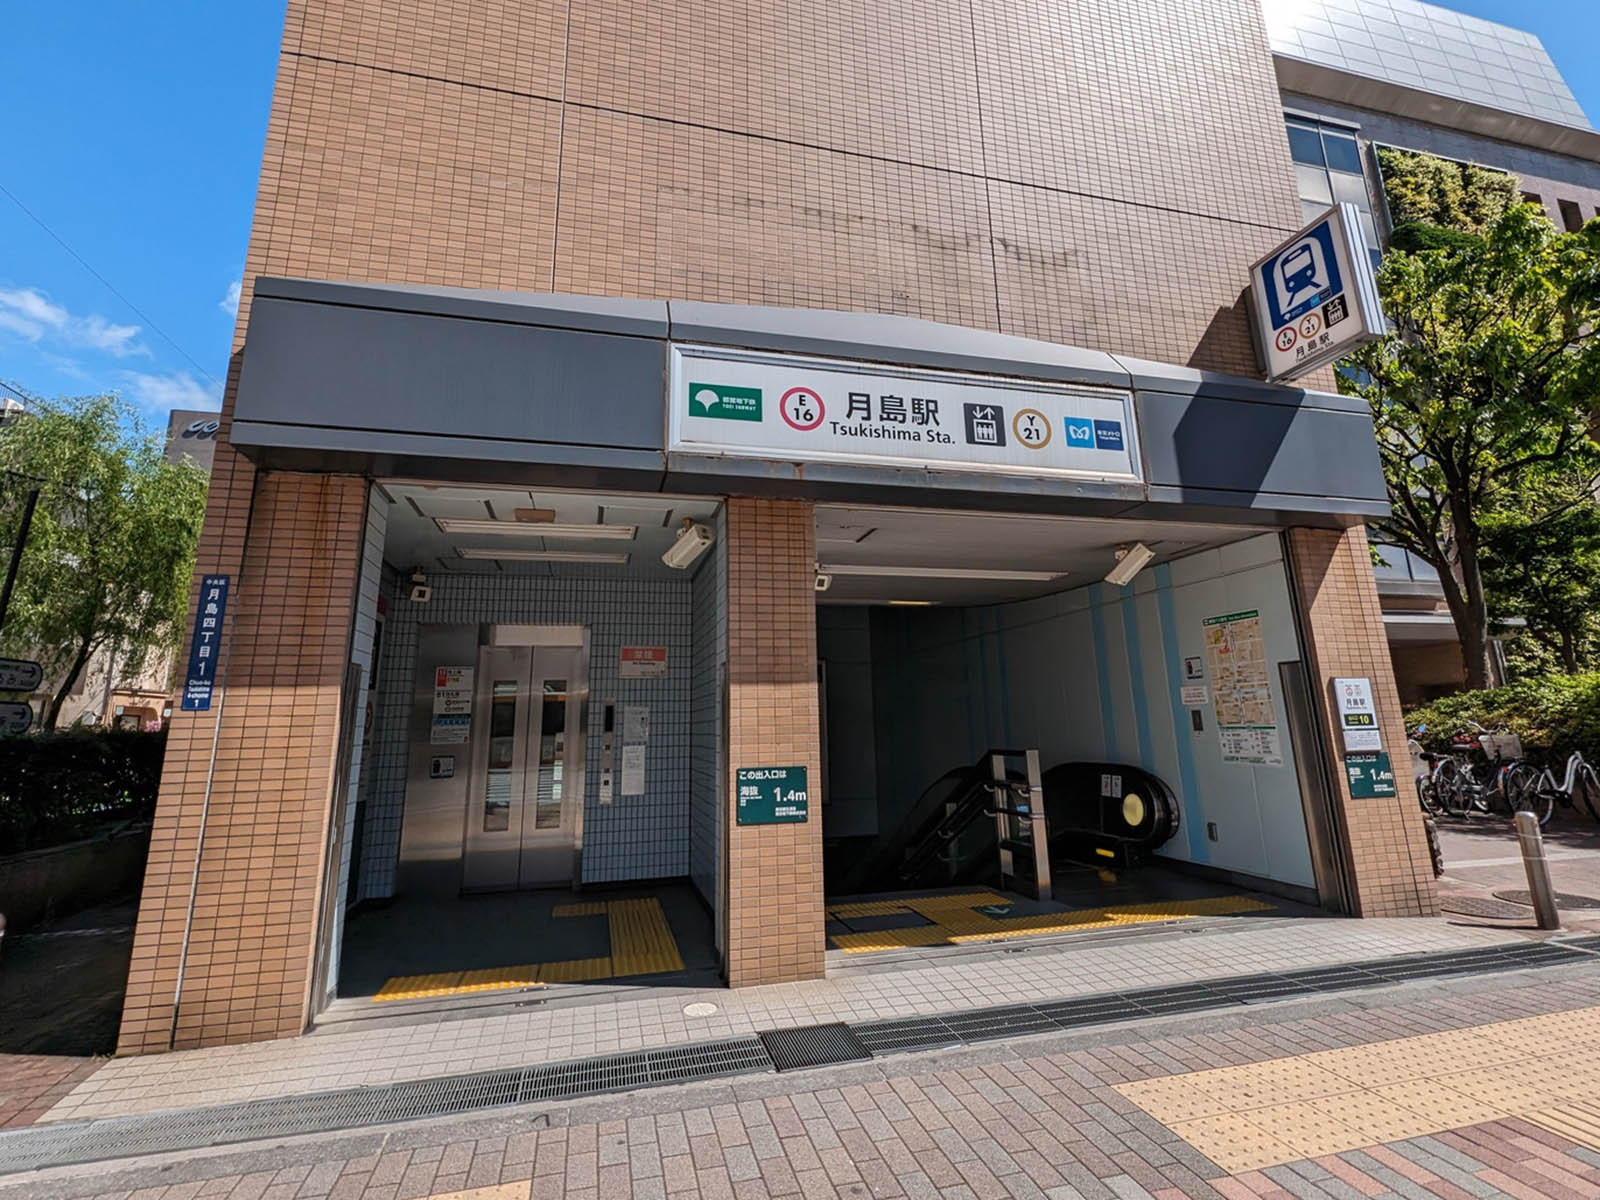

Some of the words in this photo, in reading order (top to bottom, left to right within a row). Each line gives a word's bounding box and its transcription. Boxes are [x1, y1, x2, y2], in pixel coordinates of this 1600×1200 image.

[799, 394, 806, 406] E
[793, 407, 814, 422] 16
[846, 391, 940, 427] 月島駅
[1026, 415, 1036, 426] Y
[829, 421, 921, 442] Tsukishima
[926, 429, 956, 445] Sta.
[1023, 427, 1040, 441] 21
[1359, 714, 1370, 725] 10
[739, 769, 787, 780] この出入口は
[773, 786, 807, 803] 1.4m
